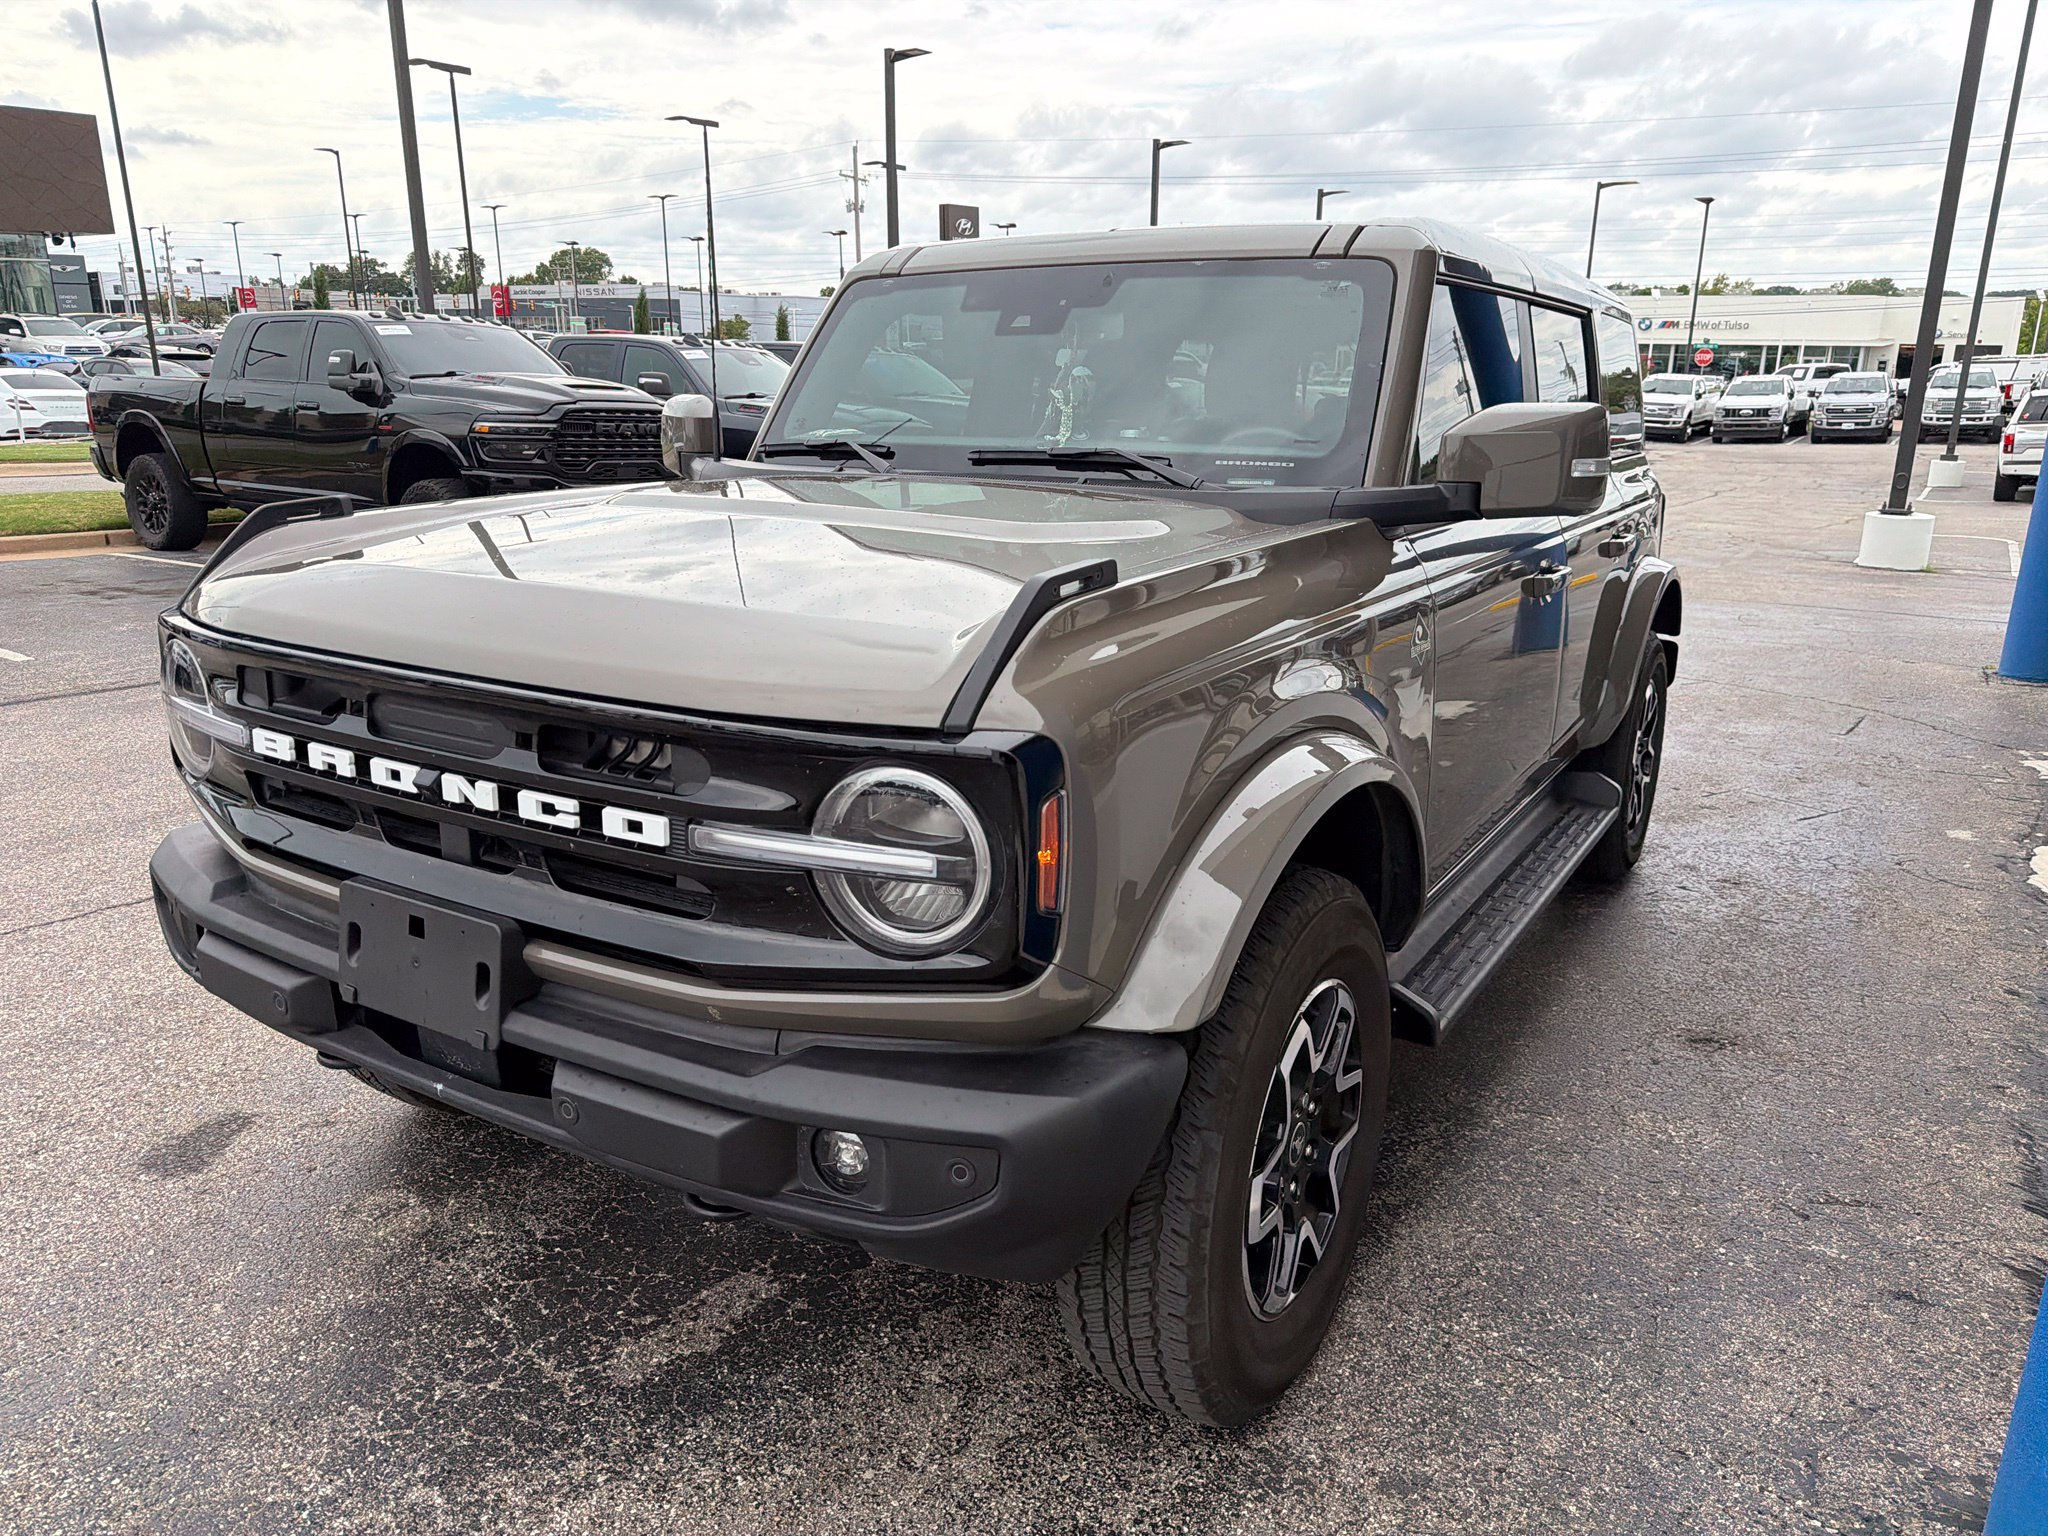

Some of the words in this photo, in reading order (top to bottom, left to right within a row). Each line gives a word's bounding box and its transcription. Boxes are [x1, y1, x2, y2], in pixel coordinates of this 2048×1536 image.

[575, 288, 615, 296] NISSAN
[1711, 321, 1721, 329] of
[1724, 321, 1750, 330] Tulsa
[1695, 353, 1713, 361] STOP
[595, 422, 661, 434] RAM
[252, 727, 670, 847] BRONCO
